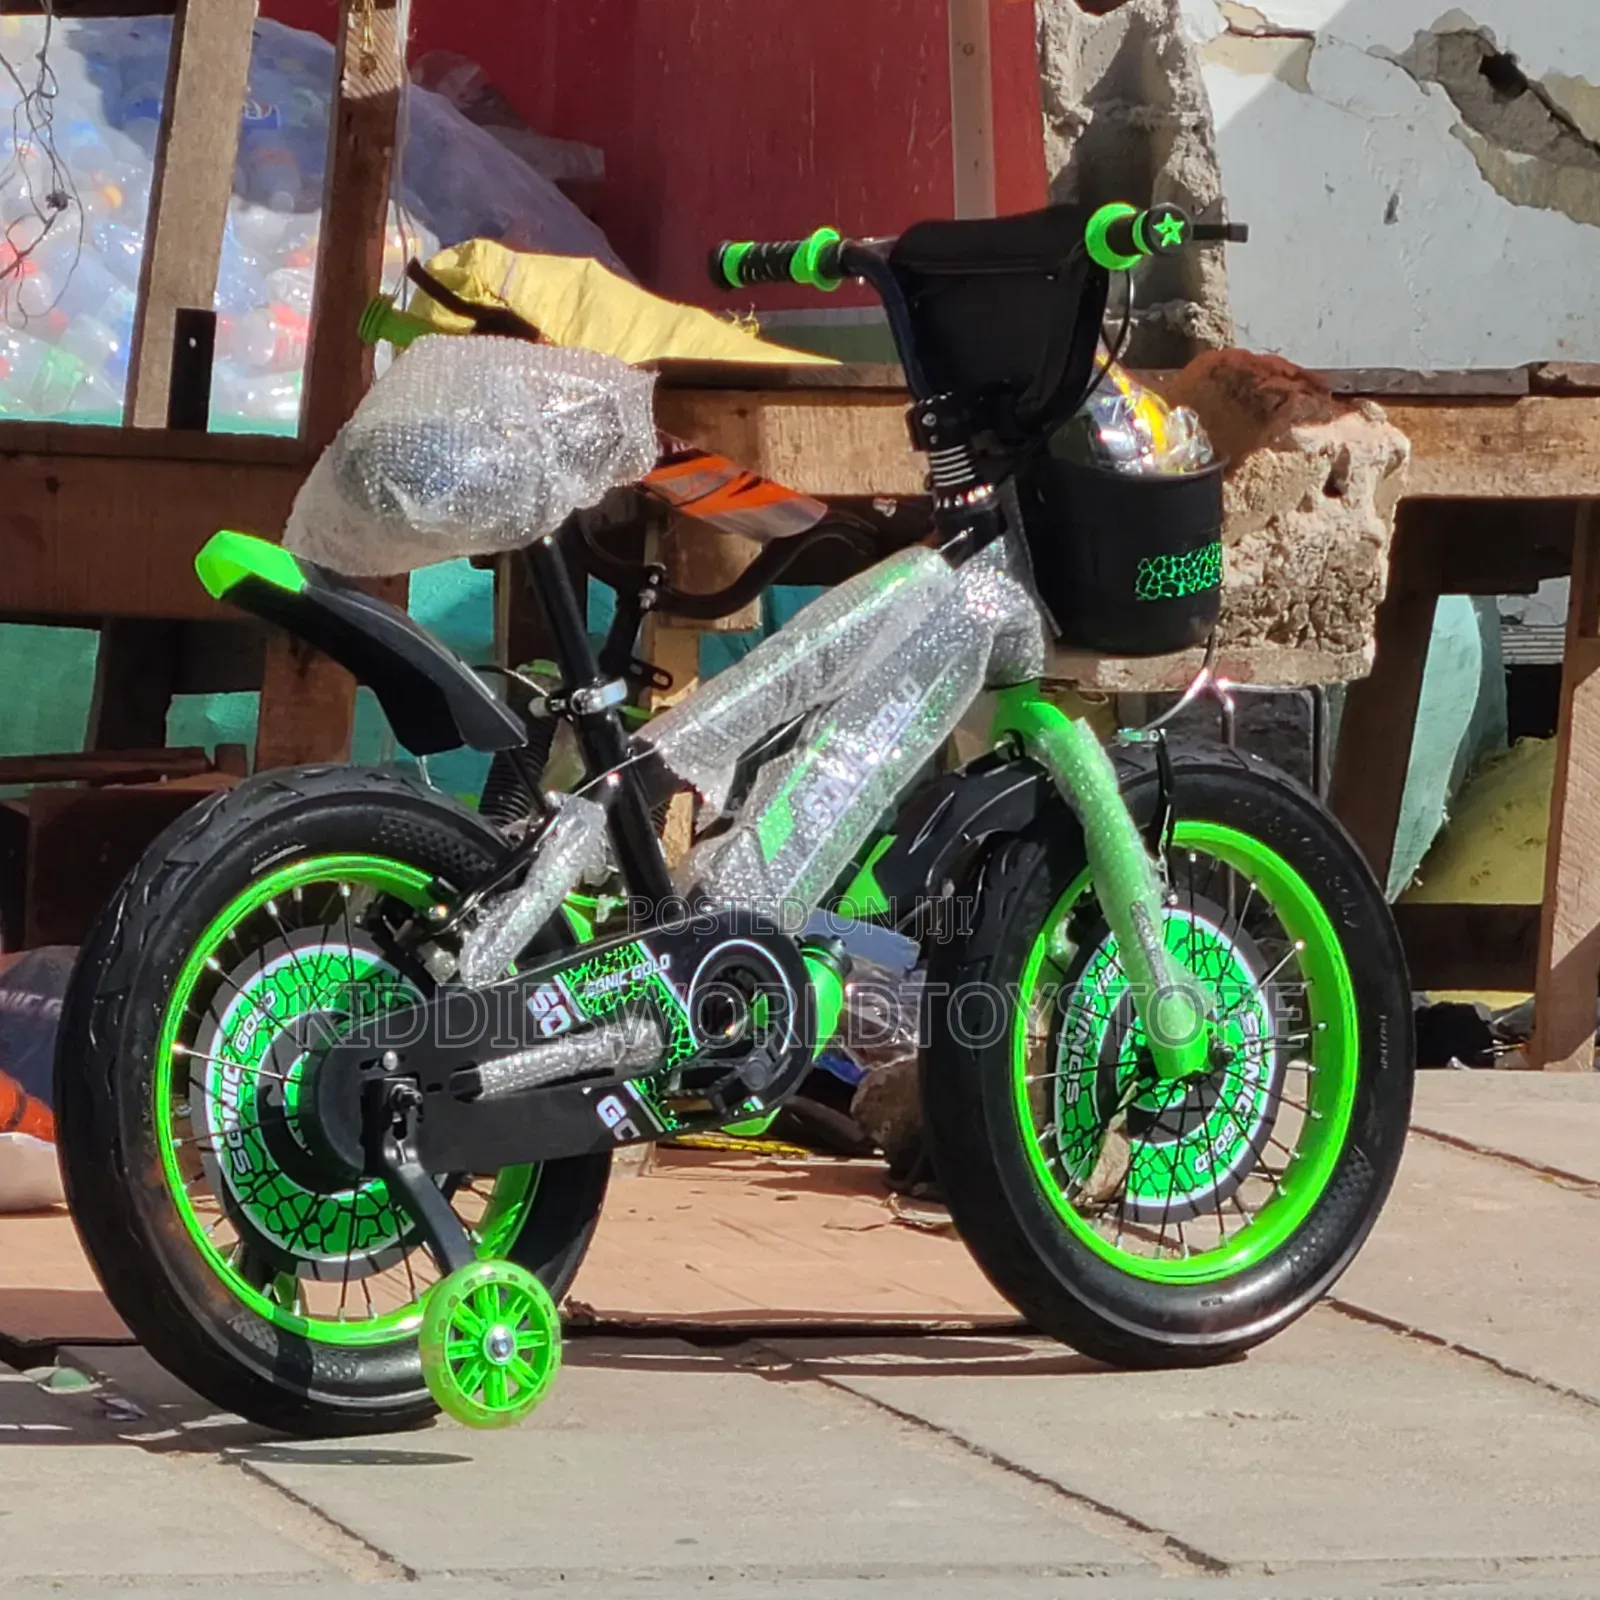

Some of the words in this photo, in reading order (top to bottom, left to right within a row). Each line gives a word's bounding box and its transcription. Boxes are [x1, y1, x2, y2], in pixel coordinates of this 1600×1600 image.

[631, 953, 671, 981] GOLD
[234, 990, 276, 1053] GOLD
[221, 1052, 254, 1175] SONIC
